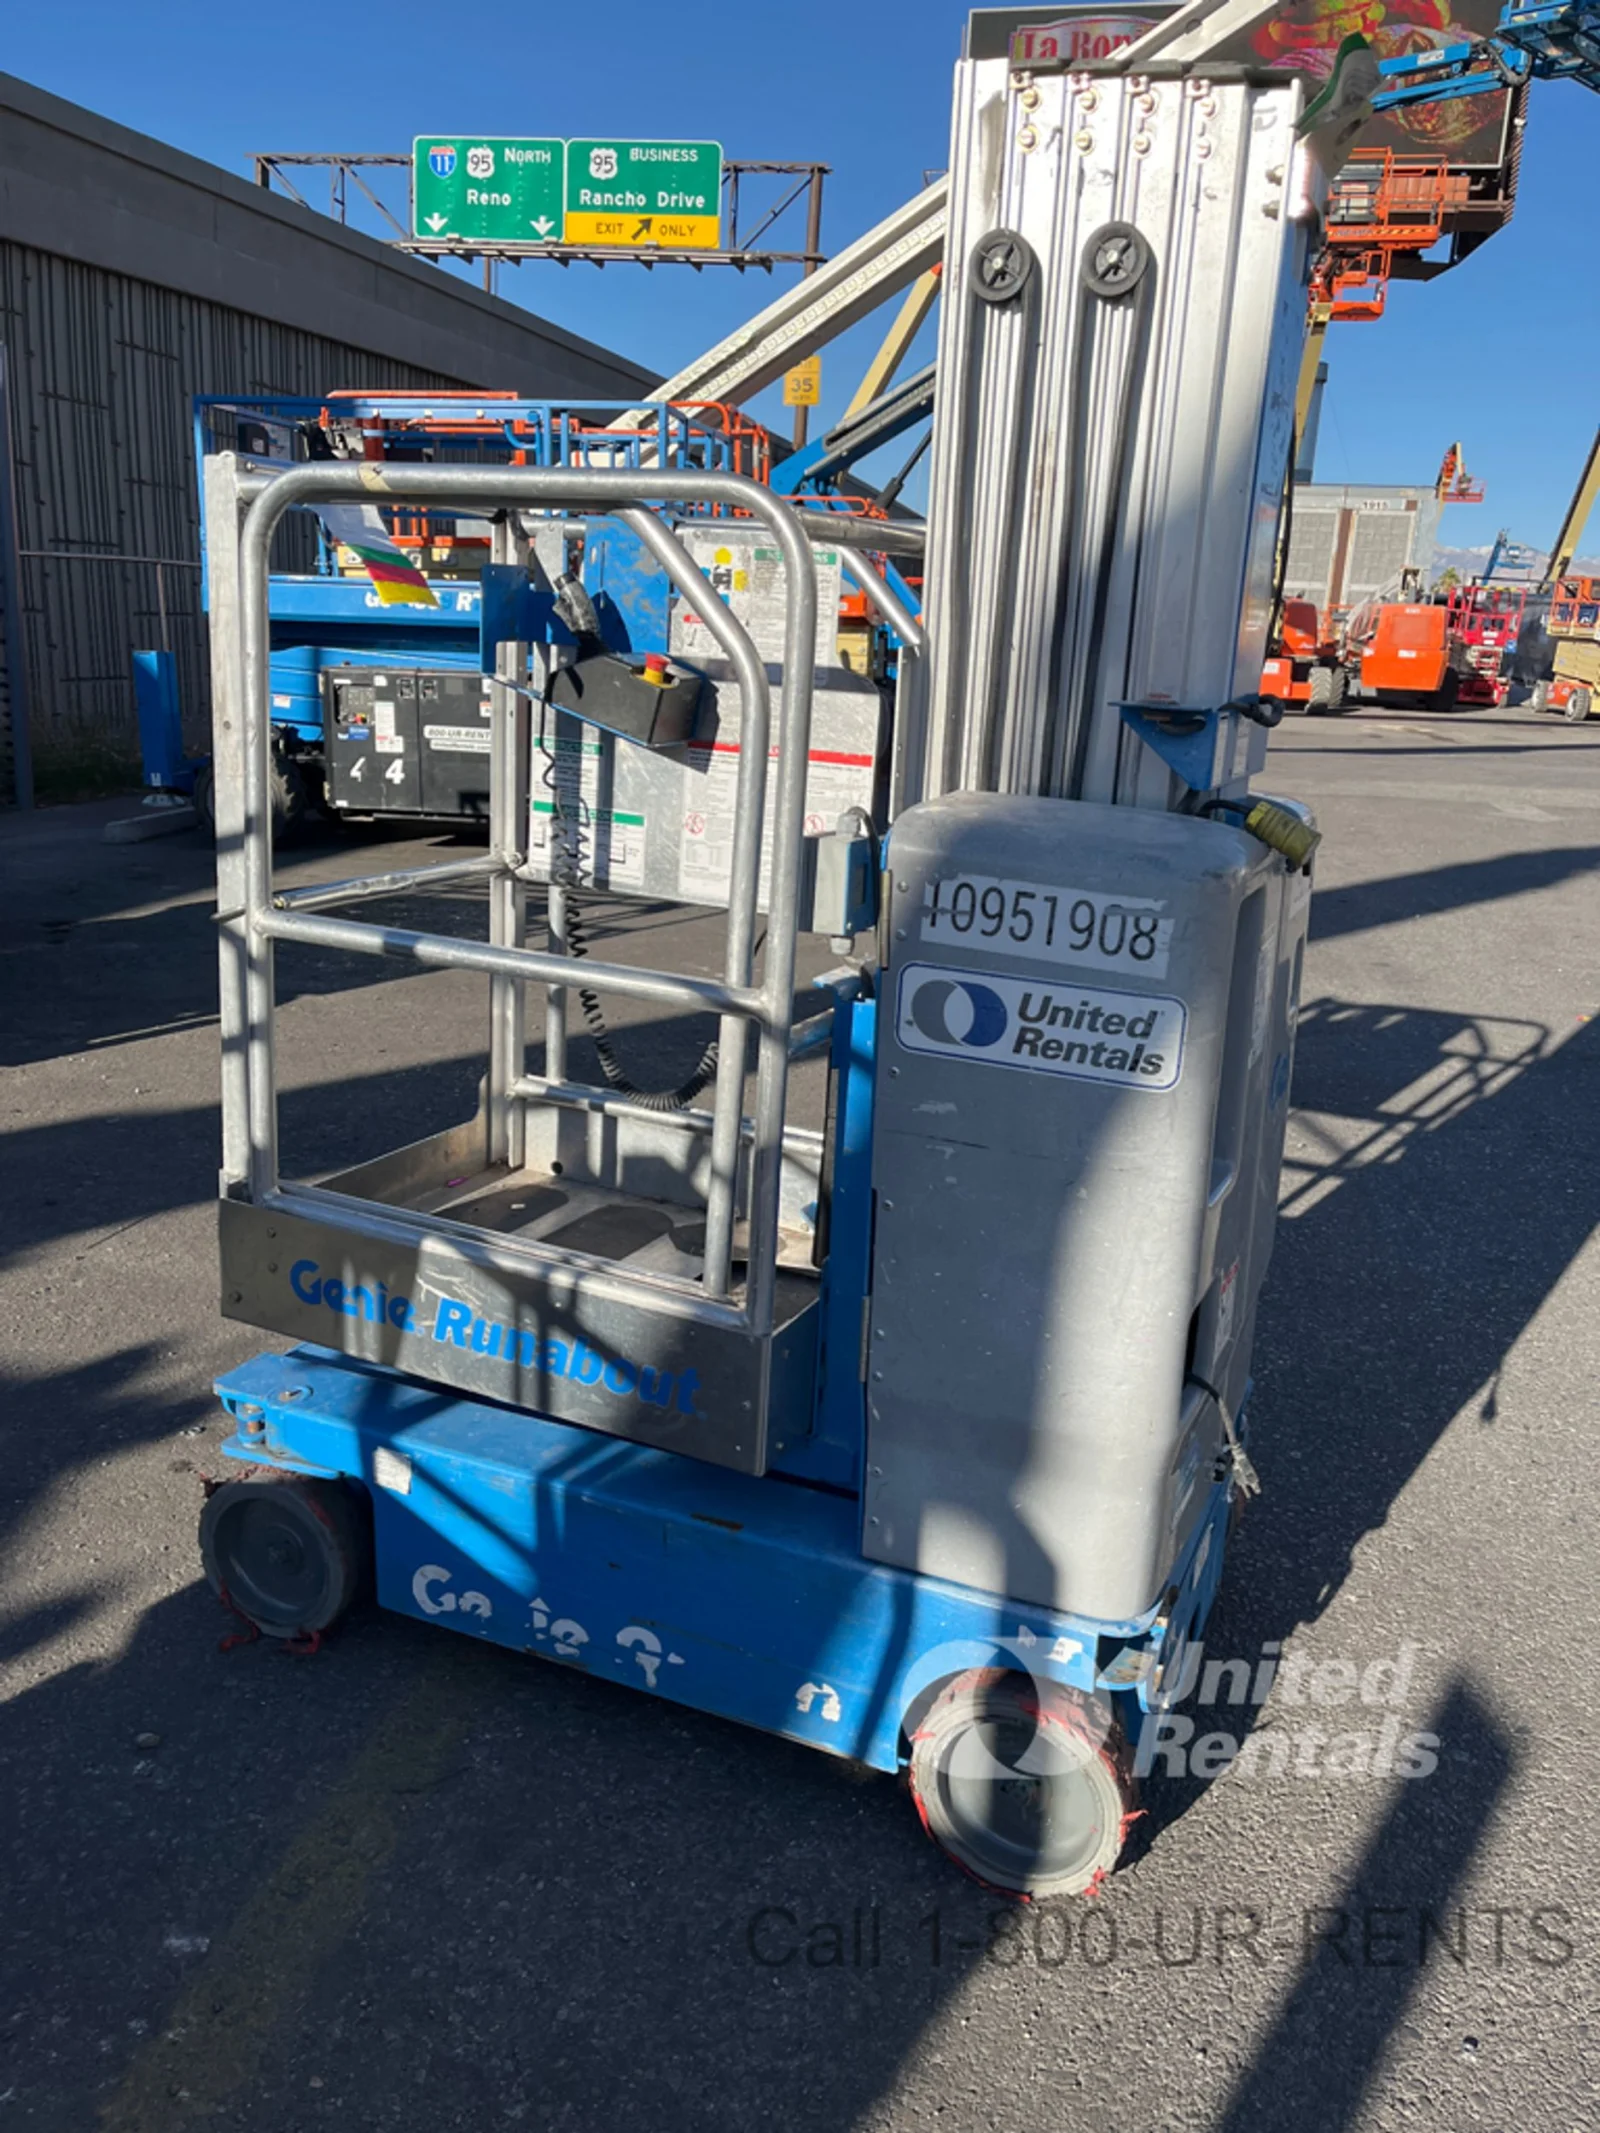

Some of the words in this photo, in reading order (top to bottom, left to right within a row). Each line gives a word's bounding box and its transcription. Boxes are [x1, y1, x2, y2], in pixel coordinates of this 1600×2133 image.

[436, 155, 450, 173] 11
[469, 153, 492, 173] 95
[503, 147, 552, 163] NORTH
[592, 154, 615, 174] 95
[629, 147, 699, 162] BUSINESS
[466, 188, 512, 206] Reno
[579, 188, 647, 206] Rancho
[656, 191, 705, 208] Drive
[595, 221, 624, 235] EXIT
[658, 224, 696, 237] ONLY
[791, 377, 814, 393] 35
[385, 758, 405, 784] 4
[929, 880, 1159, 961] 10951908
[1017, 991, 1159, 1039] United
[1012, 1026, 1165, 1076] Rentals
[289, 1258, 416, 1333] Genie
[433, 1297, 702, 1416] Runabout
